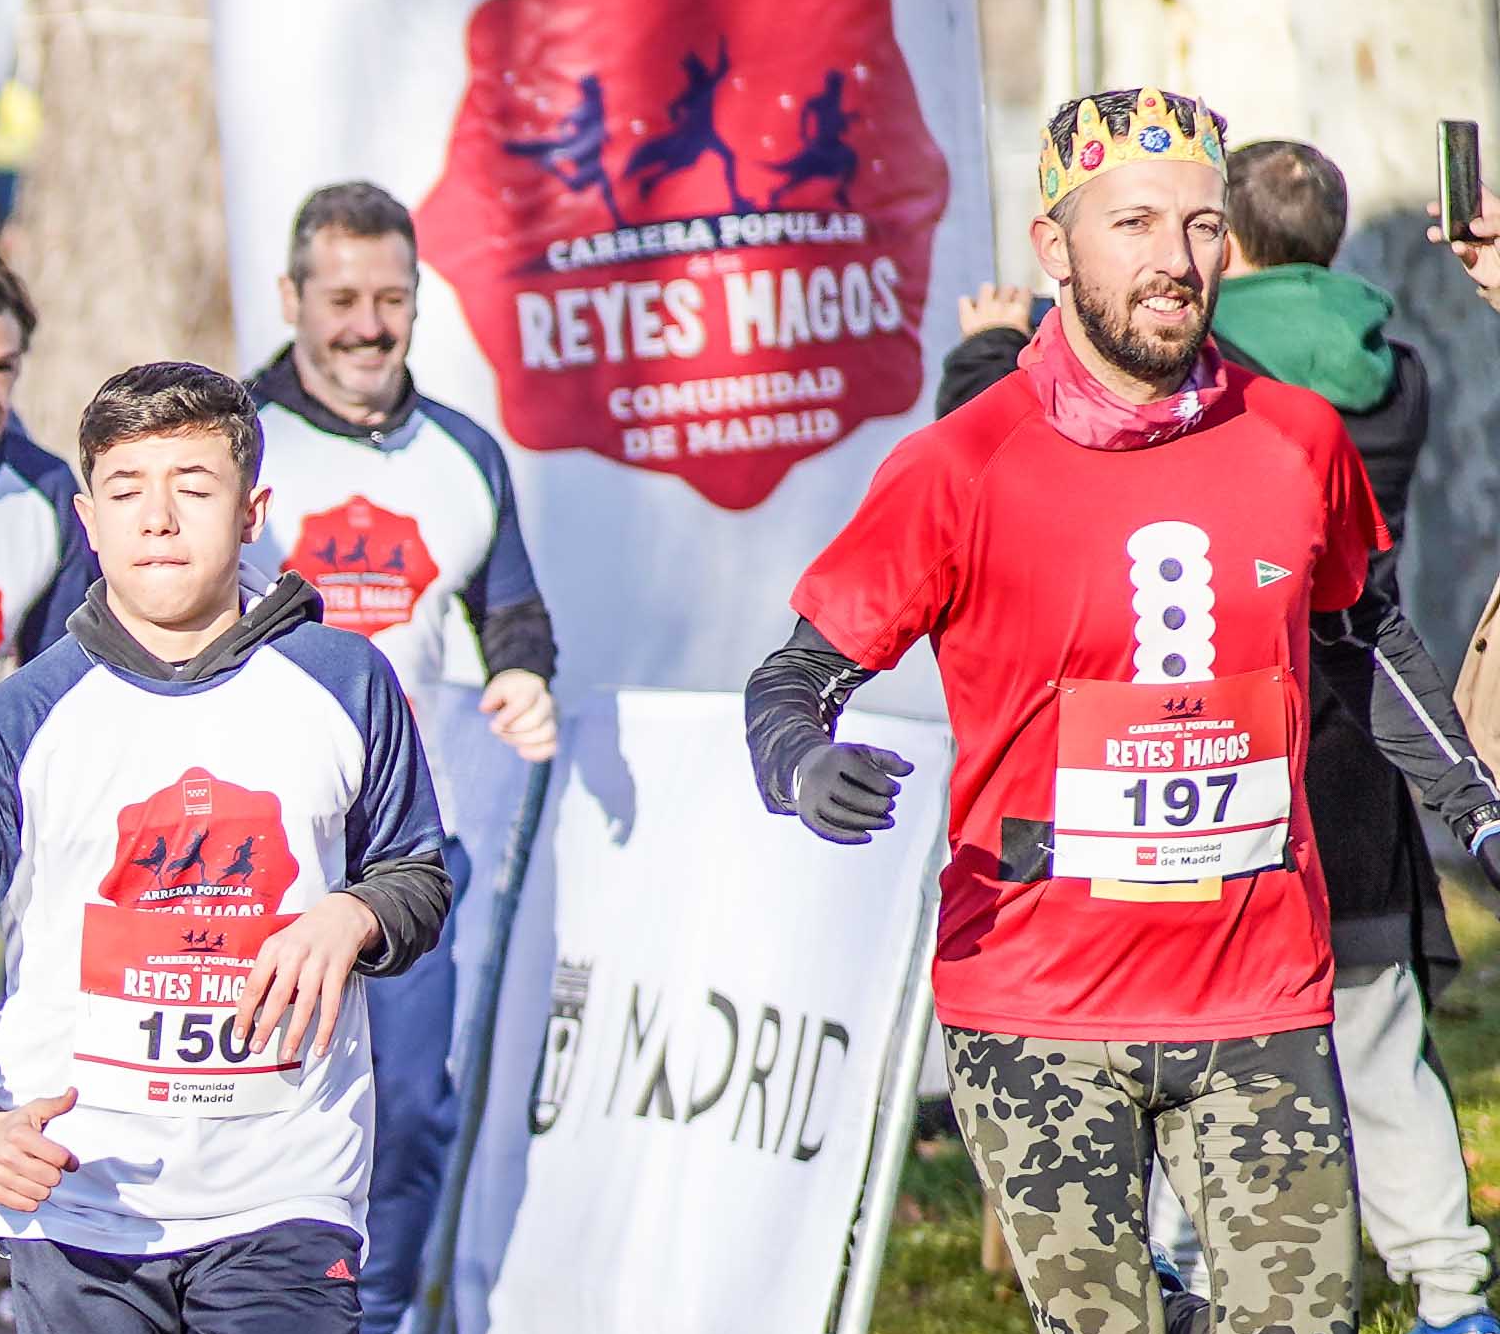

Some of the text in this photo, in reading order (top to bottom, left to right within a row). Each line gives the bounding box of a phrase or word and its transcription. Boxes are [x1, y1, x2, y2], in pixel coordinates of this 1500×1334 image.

[547, 213, 866, 272] CARRERA POPULAR
[517, 257, 901, 370] REYES MAGOS
[609, 367, 845, 422] COMUNIDAD
[623, 409, 842, 460] DE MADRID
[1185, 719, 1236, 731] POPULAR
[1105, 732, 1251, 769] REYES MAGOS
[1123, 772, 1239, 828] 197
[1160, 842, 1222, 855] Comunidad
[1160, 853, 1222, 867] de Madrid
[139, 884, 253, 902] ARRERA POPULAR
[147, 955, 202, 966] CARRERA
[123, 968, 246, 1004] REYES MAG
[138, 1010, 257, 1064] 150
[172, 1082, 235, 1092] Comunidad
[605, 982, 849, 1161] MADRID
[172, 1093, 233, 1104] de Madrid
